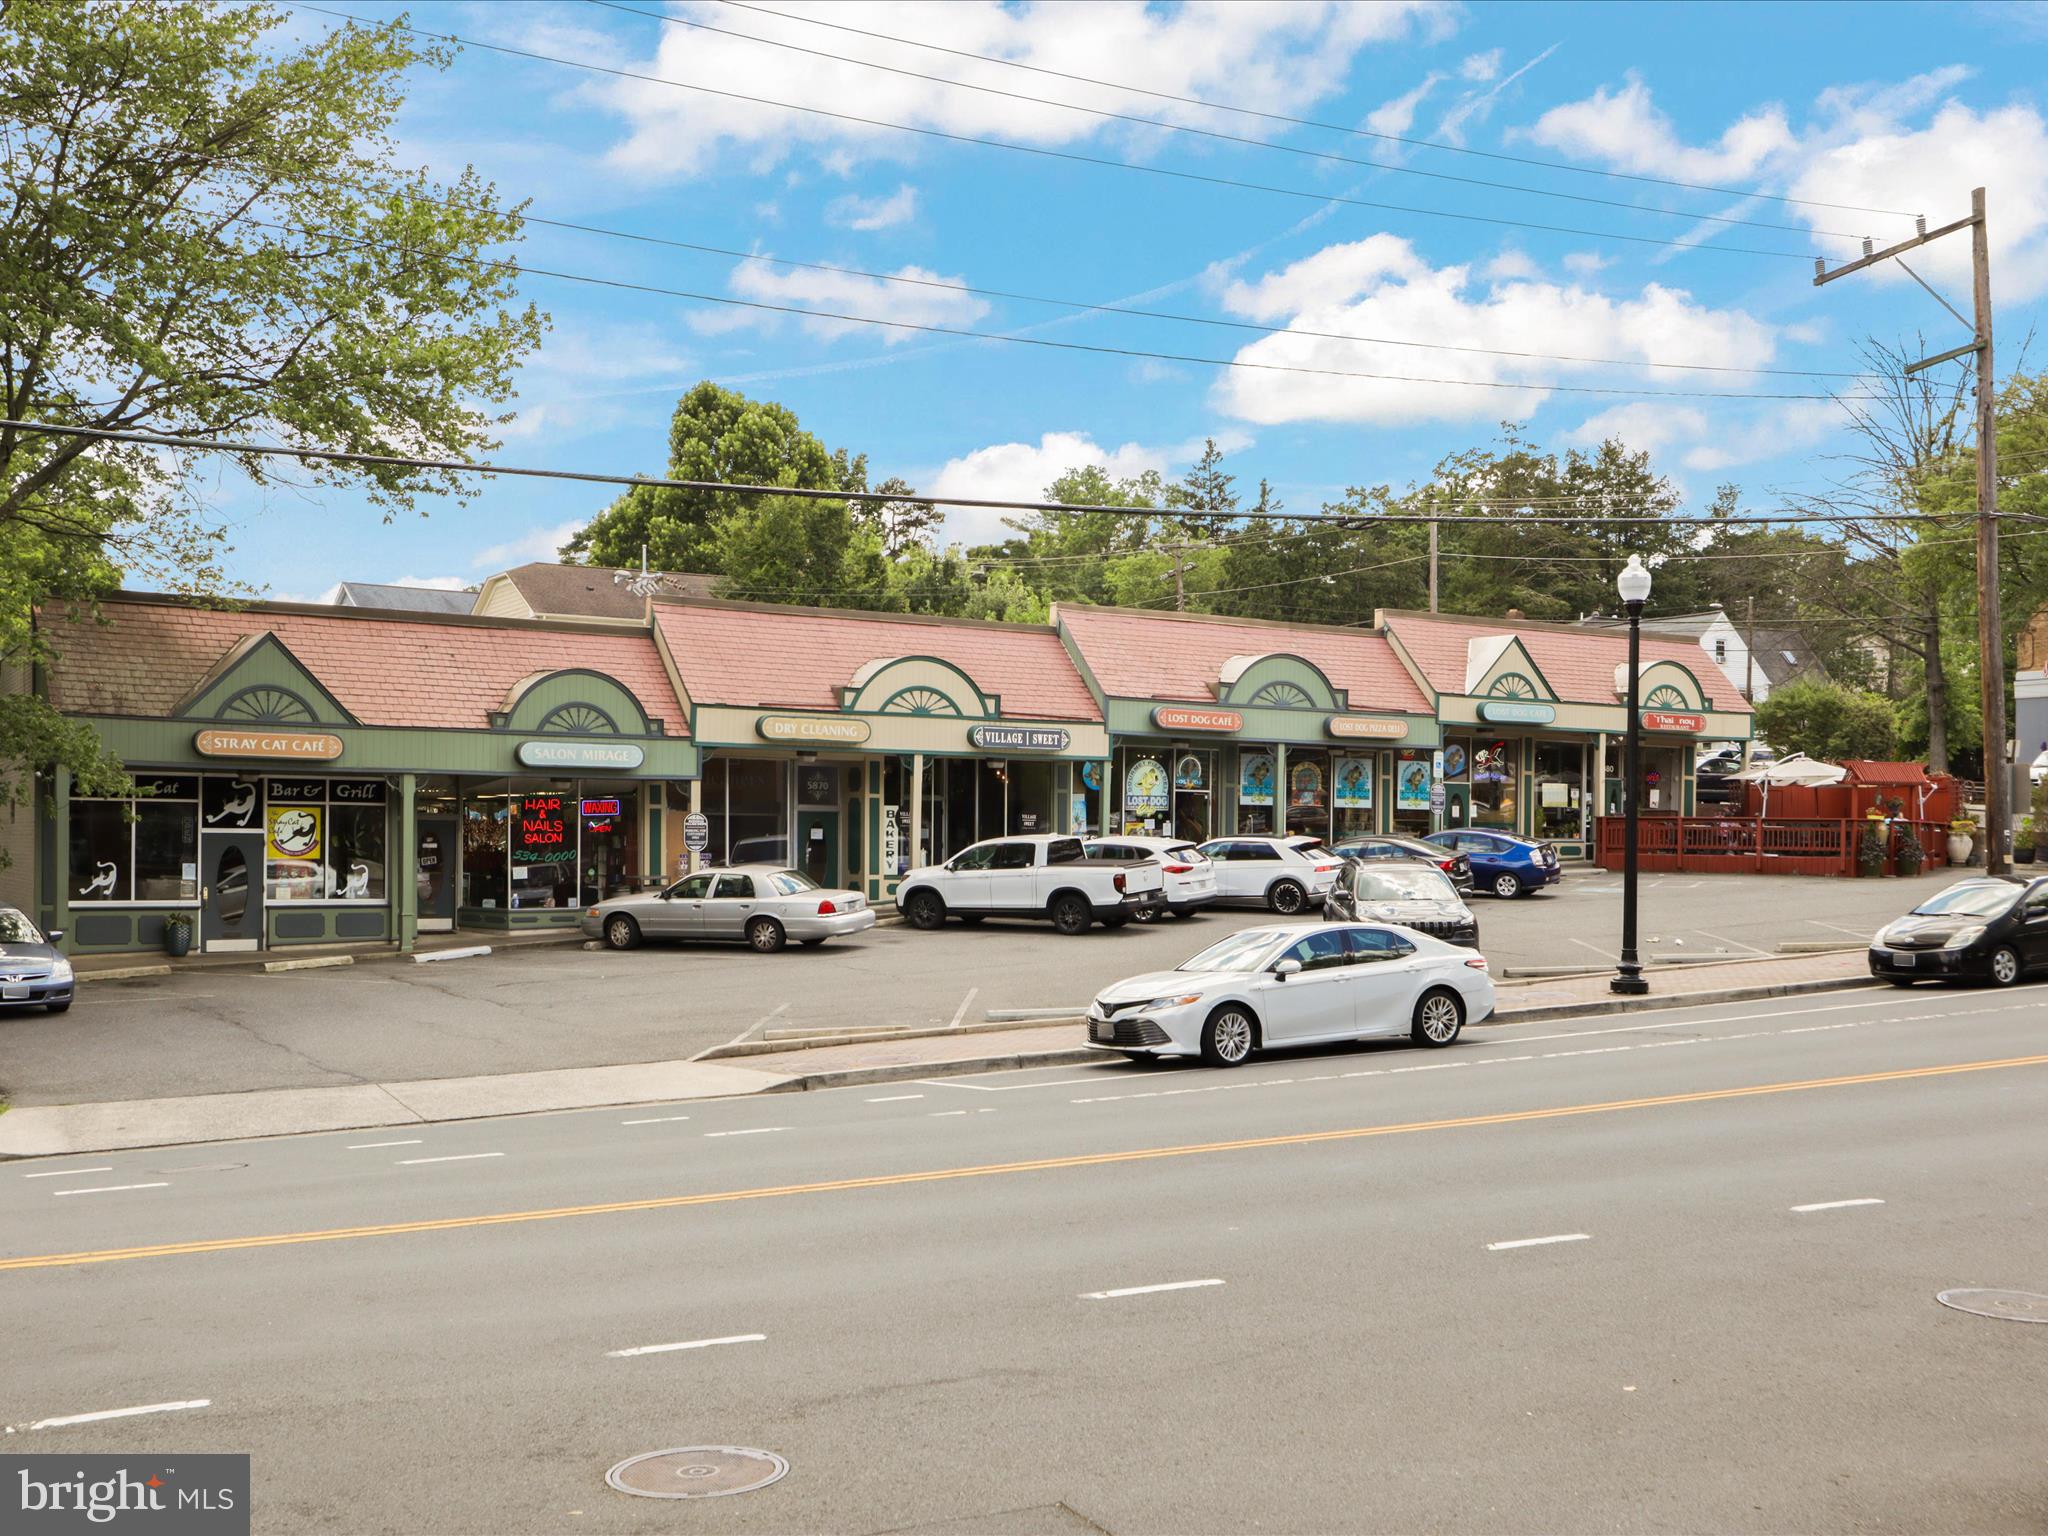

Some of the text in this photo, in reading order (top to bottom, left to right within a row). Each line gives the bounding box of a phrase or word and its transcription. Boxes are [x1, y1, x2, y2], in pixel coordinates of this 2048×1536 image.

[1168, 713, 1233, 726] LOST DOG CAFÉ
[1653, 715, 1674, 724] Thai
[775, 722, 857, 737] DRY CLEANING
[1355, 723, 1369, 732] DOG
[1370, 724, 1387, 733] PIZZA
[214, 737, 325, 752] STRAY CAT CAFÉ
[985, 732, 1060, 746] VILLAGE SWEET
[534, 747, 630, 762] SALON MIRAGE
[153, 781, 179, 794] Cat
[271, 783, 376, 798] Bar & Grill
[807, 781, 829, 790] 5870
[525, 798, 561, 811] HAIR
[584, 801, 617, 814] WAXING
[1127, 796, 1168, 806] LOST DOG
[539, 809, 547, 819] &
[288, 817, 300, 826] Cat
[523, 820, 564, 832] NAILS
[524, 832, 563, 844] SALON
[886, 810, 895, 869] BAKERY
[512, 849, 577, 863] 534-0000
